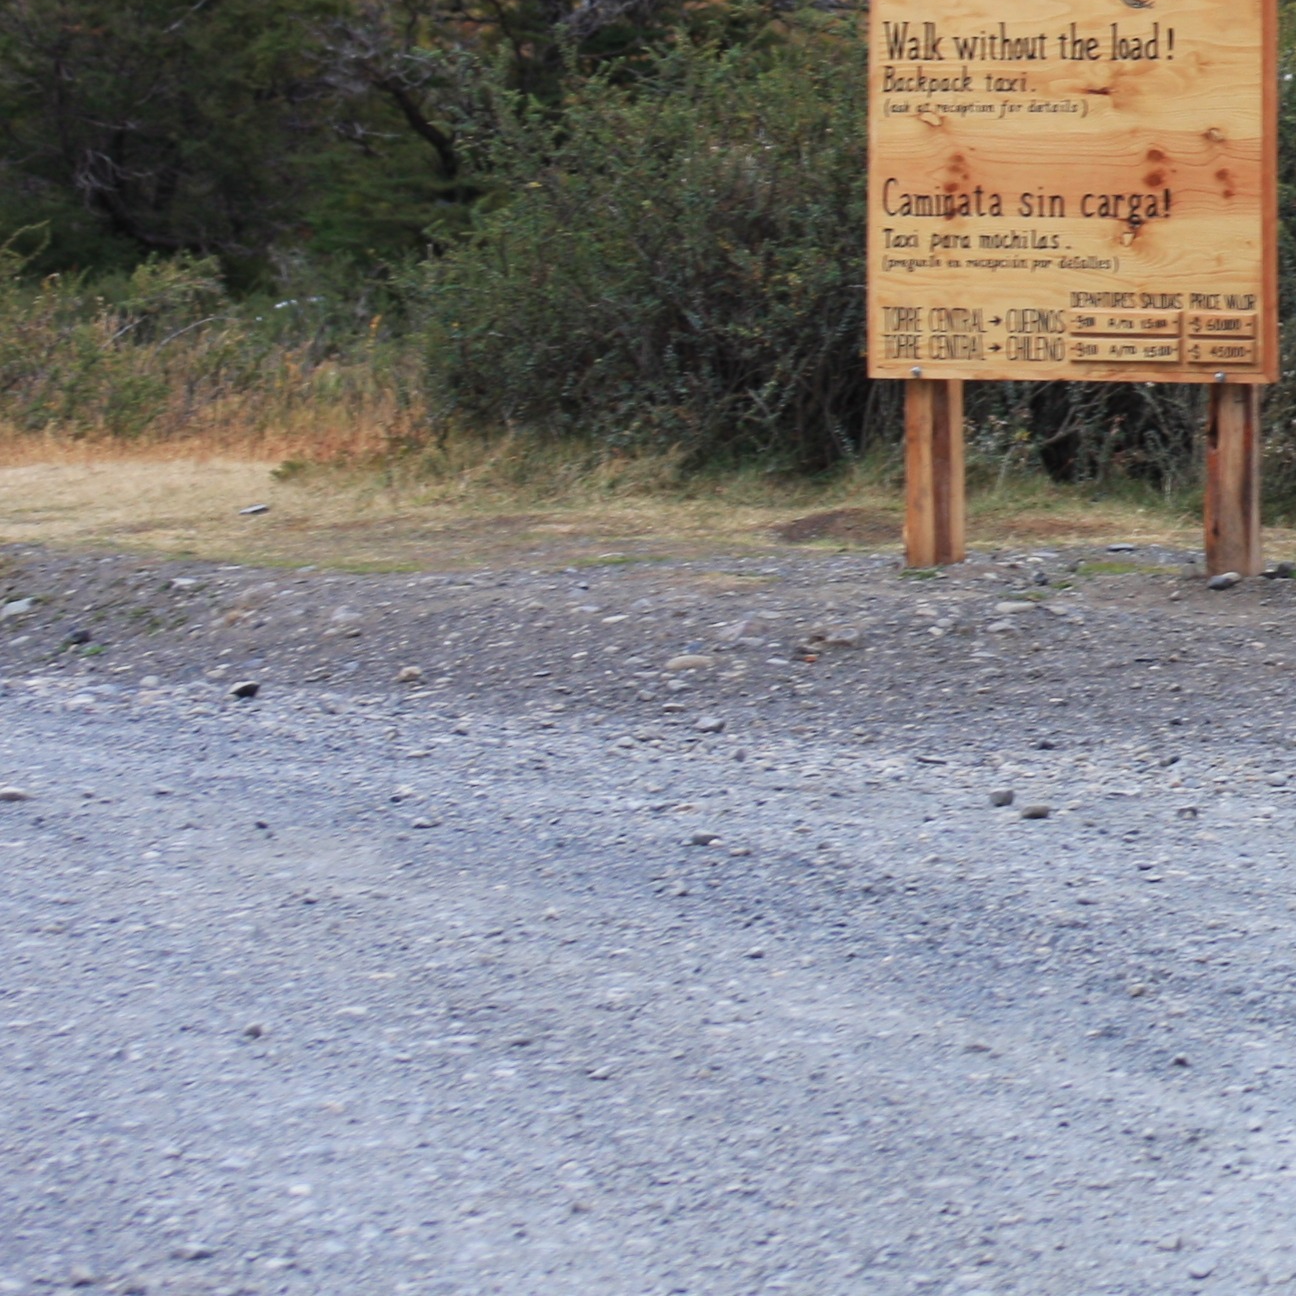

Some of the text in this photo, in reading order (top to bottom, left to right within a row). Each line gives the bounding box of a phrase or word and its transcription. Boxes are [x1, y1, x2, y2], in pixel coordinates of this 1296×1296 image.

[882, 21, 945, 61] Walk
[952, 21, 1048, 61] without
[1058, 21, 1100, 61] the
[882, 65, 973, 97] Backpack
[935, 100, 995, 117] reception
[999, 100, 1022, 119] for
[882, 177, 1173, 228] Caminata sin carga!
[882, 228, 918, 249] Taxi
[930, 233, 971, 251] para
[947, 259, 961, 268] en
[1031, 259, 1051, 272] por
[1070, 292, 1183, 310] DEPARTURES SALIDAS
[1190, 293, 1257, 311] PRICE VALOR
[883, 306, 987, 333] TORRE CENTRAL
[1005, 308, 1066, 334] CUERNOS
[883, 334, 987, 361] TORRE CENTRAL
[1005, 336, 1066, 361] CHILENO
